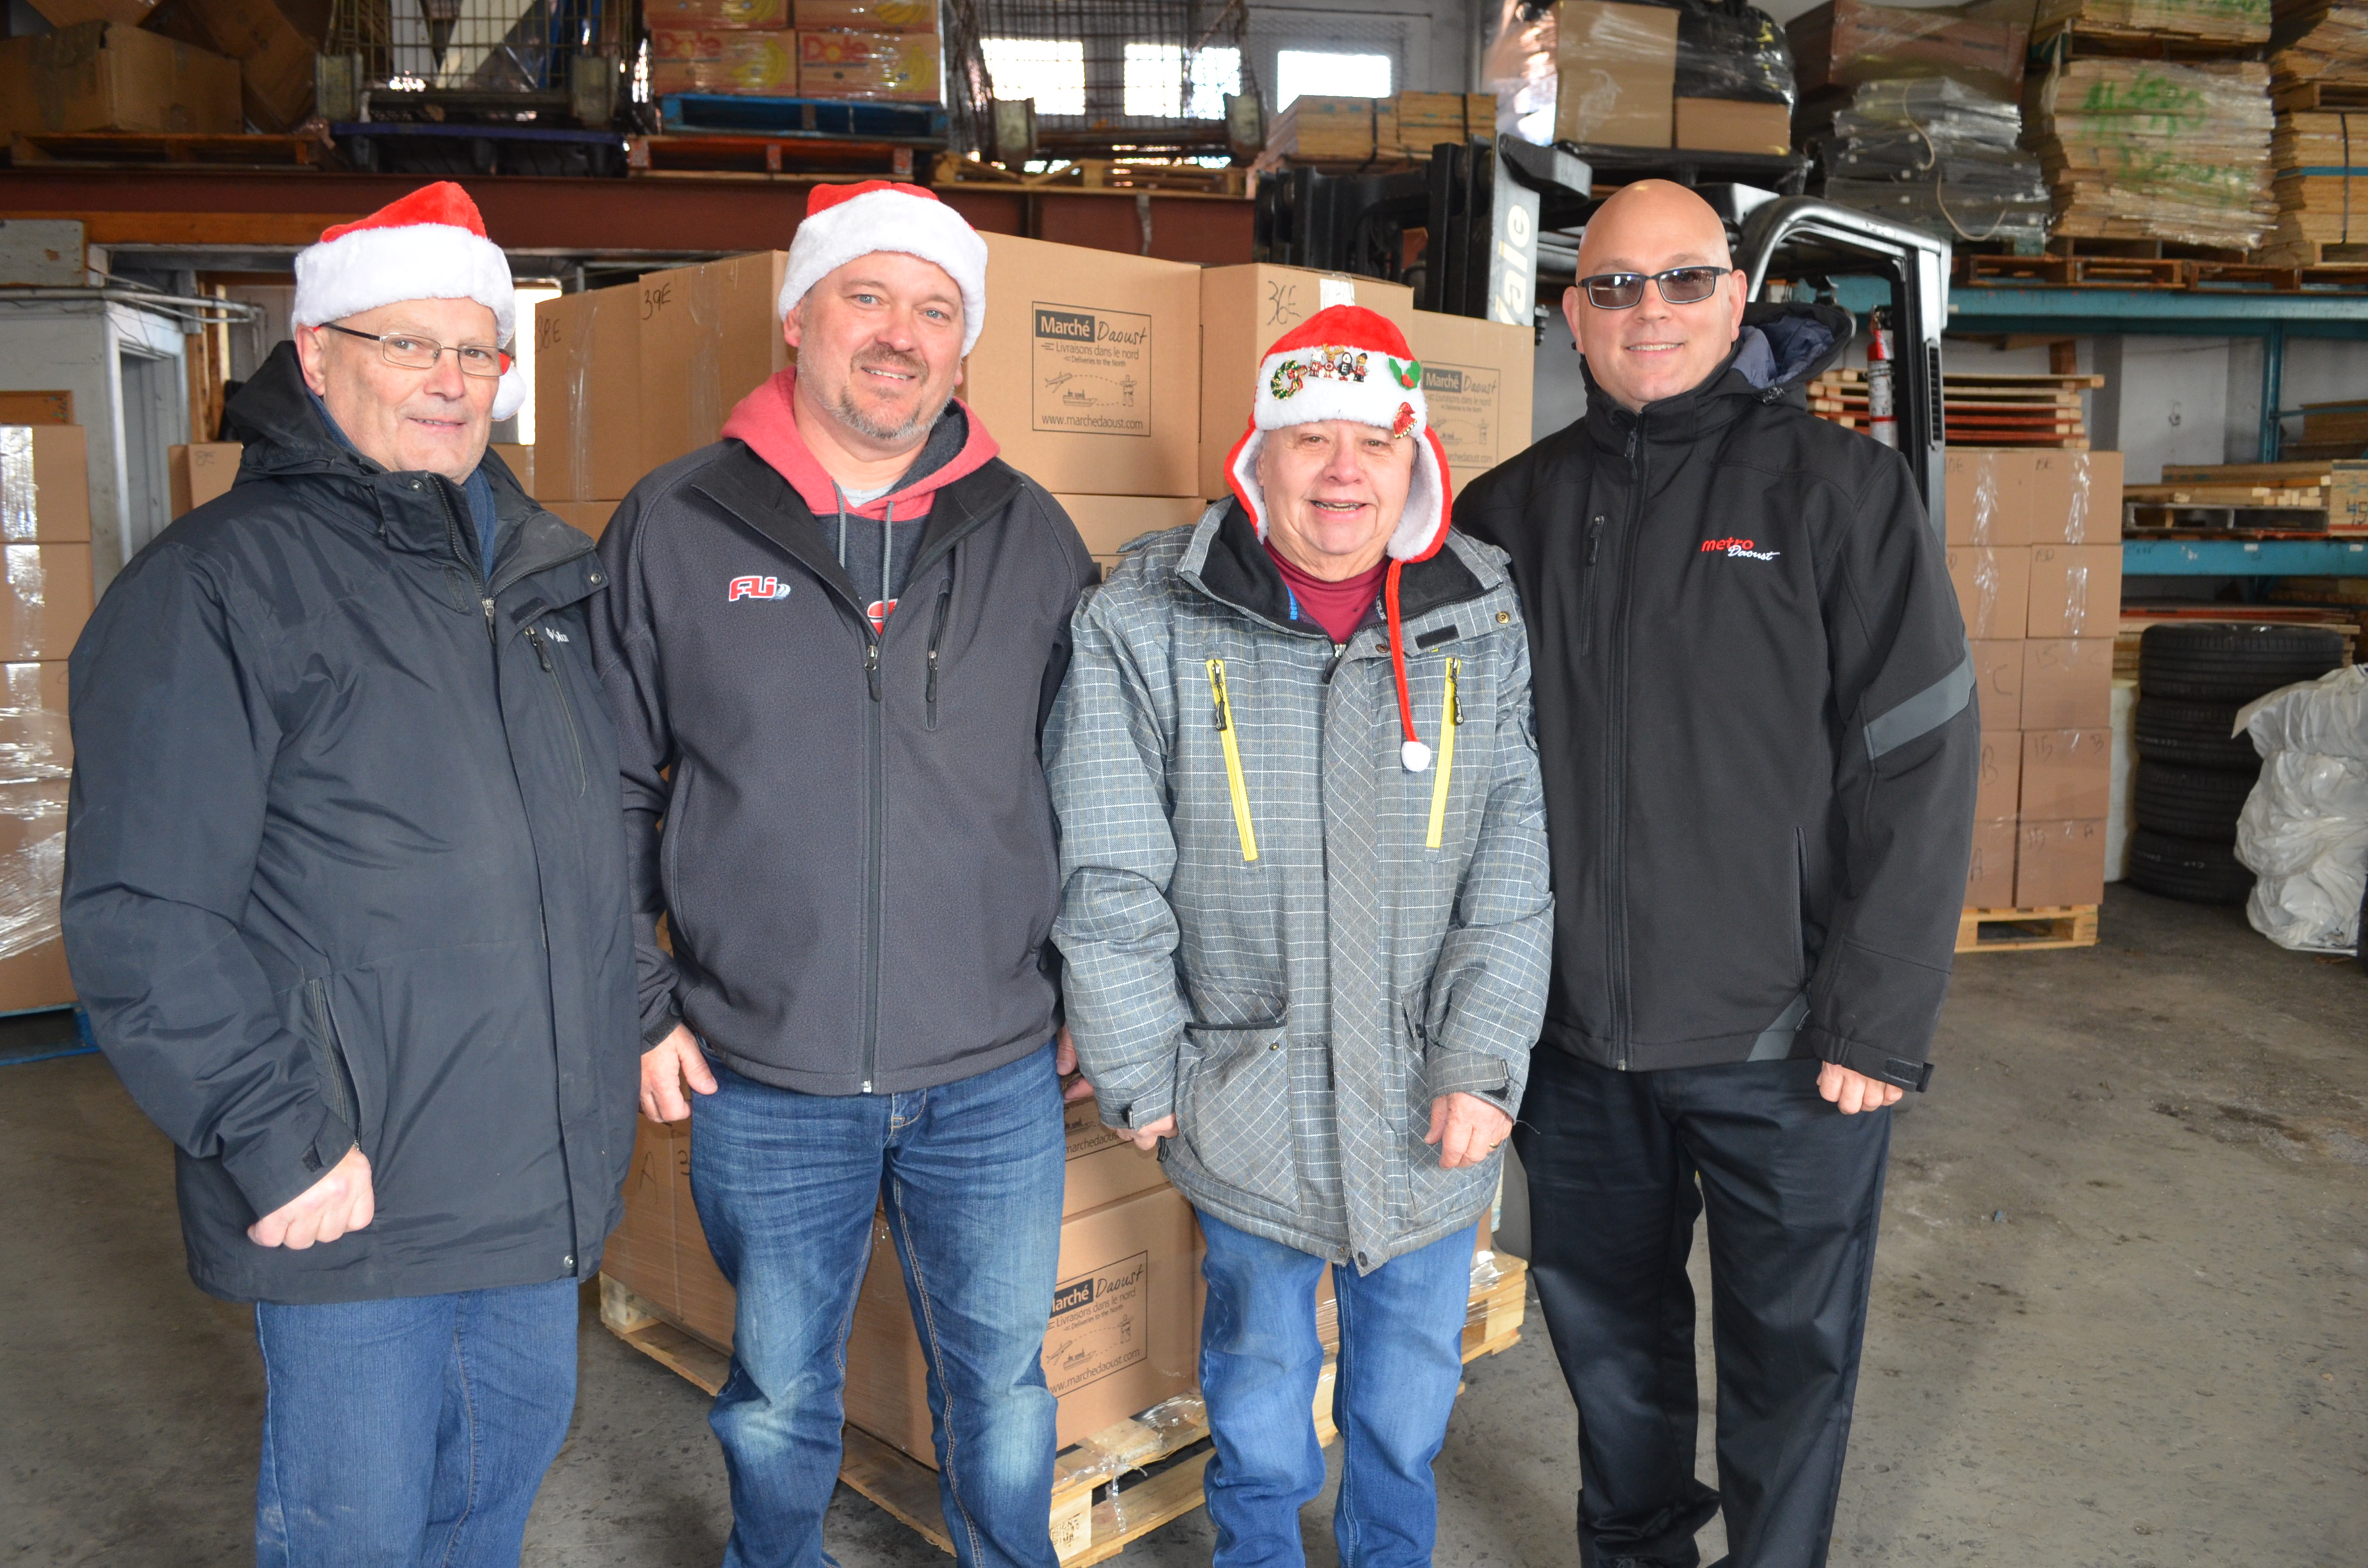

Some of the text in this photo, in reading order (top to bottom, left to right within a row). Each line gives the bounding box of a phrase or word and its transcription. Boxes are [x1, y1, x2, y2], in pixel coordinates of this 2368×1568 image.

[654, 31, 723, 57] Dole
[803, 35, 869, 63] Dole
[1040, 315, 1147, 345] Marché Daoust
[1056, 341, 1139, 360] Livraisons dans le nord
[1071, 355, 1096, 365] Deliveries
[1103, 357, 1111, 366] the
[1112, 359, 1126, 368] North
[1426, 372, 1497, 394] Marché Daoust
[1041, 414, 1144, 430] www.marchedaoust.com
[1700, 537, 1755, 552] metro
[1727, 544, 1780, 561] Daoust
[1066, 1131, 1121, 1155] marchedaous
[1095, 1263, 1144, 1298] Daoust
[1056, 1286, 1137, 1328] Livraisons dans le nord
[1071, 1316, 1094, 1330] Deliveries
[1110, 1303, 1124, 1314] North
[1049, 1348, 1140, 1394] ww.marchedaoust.com
